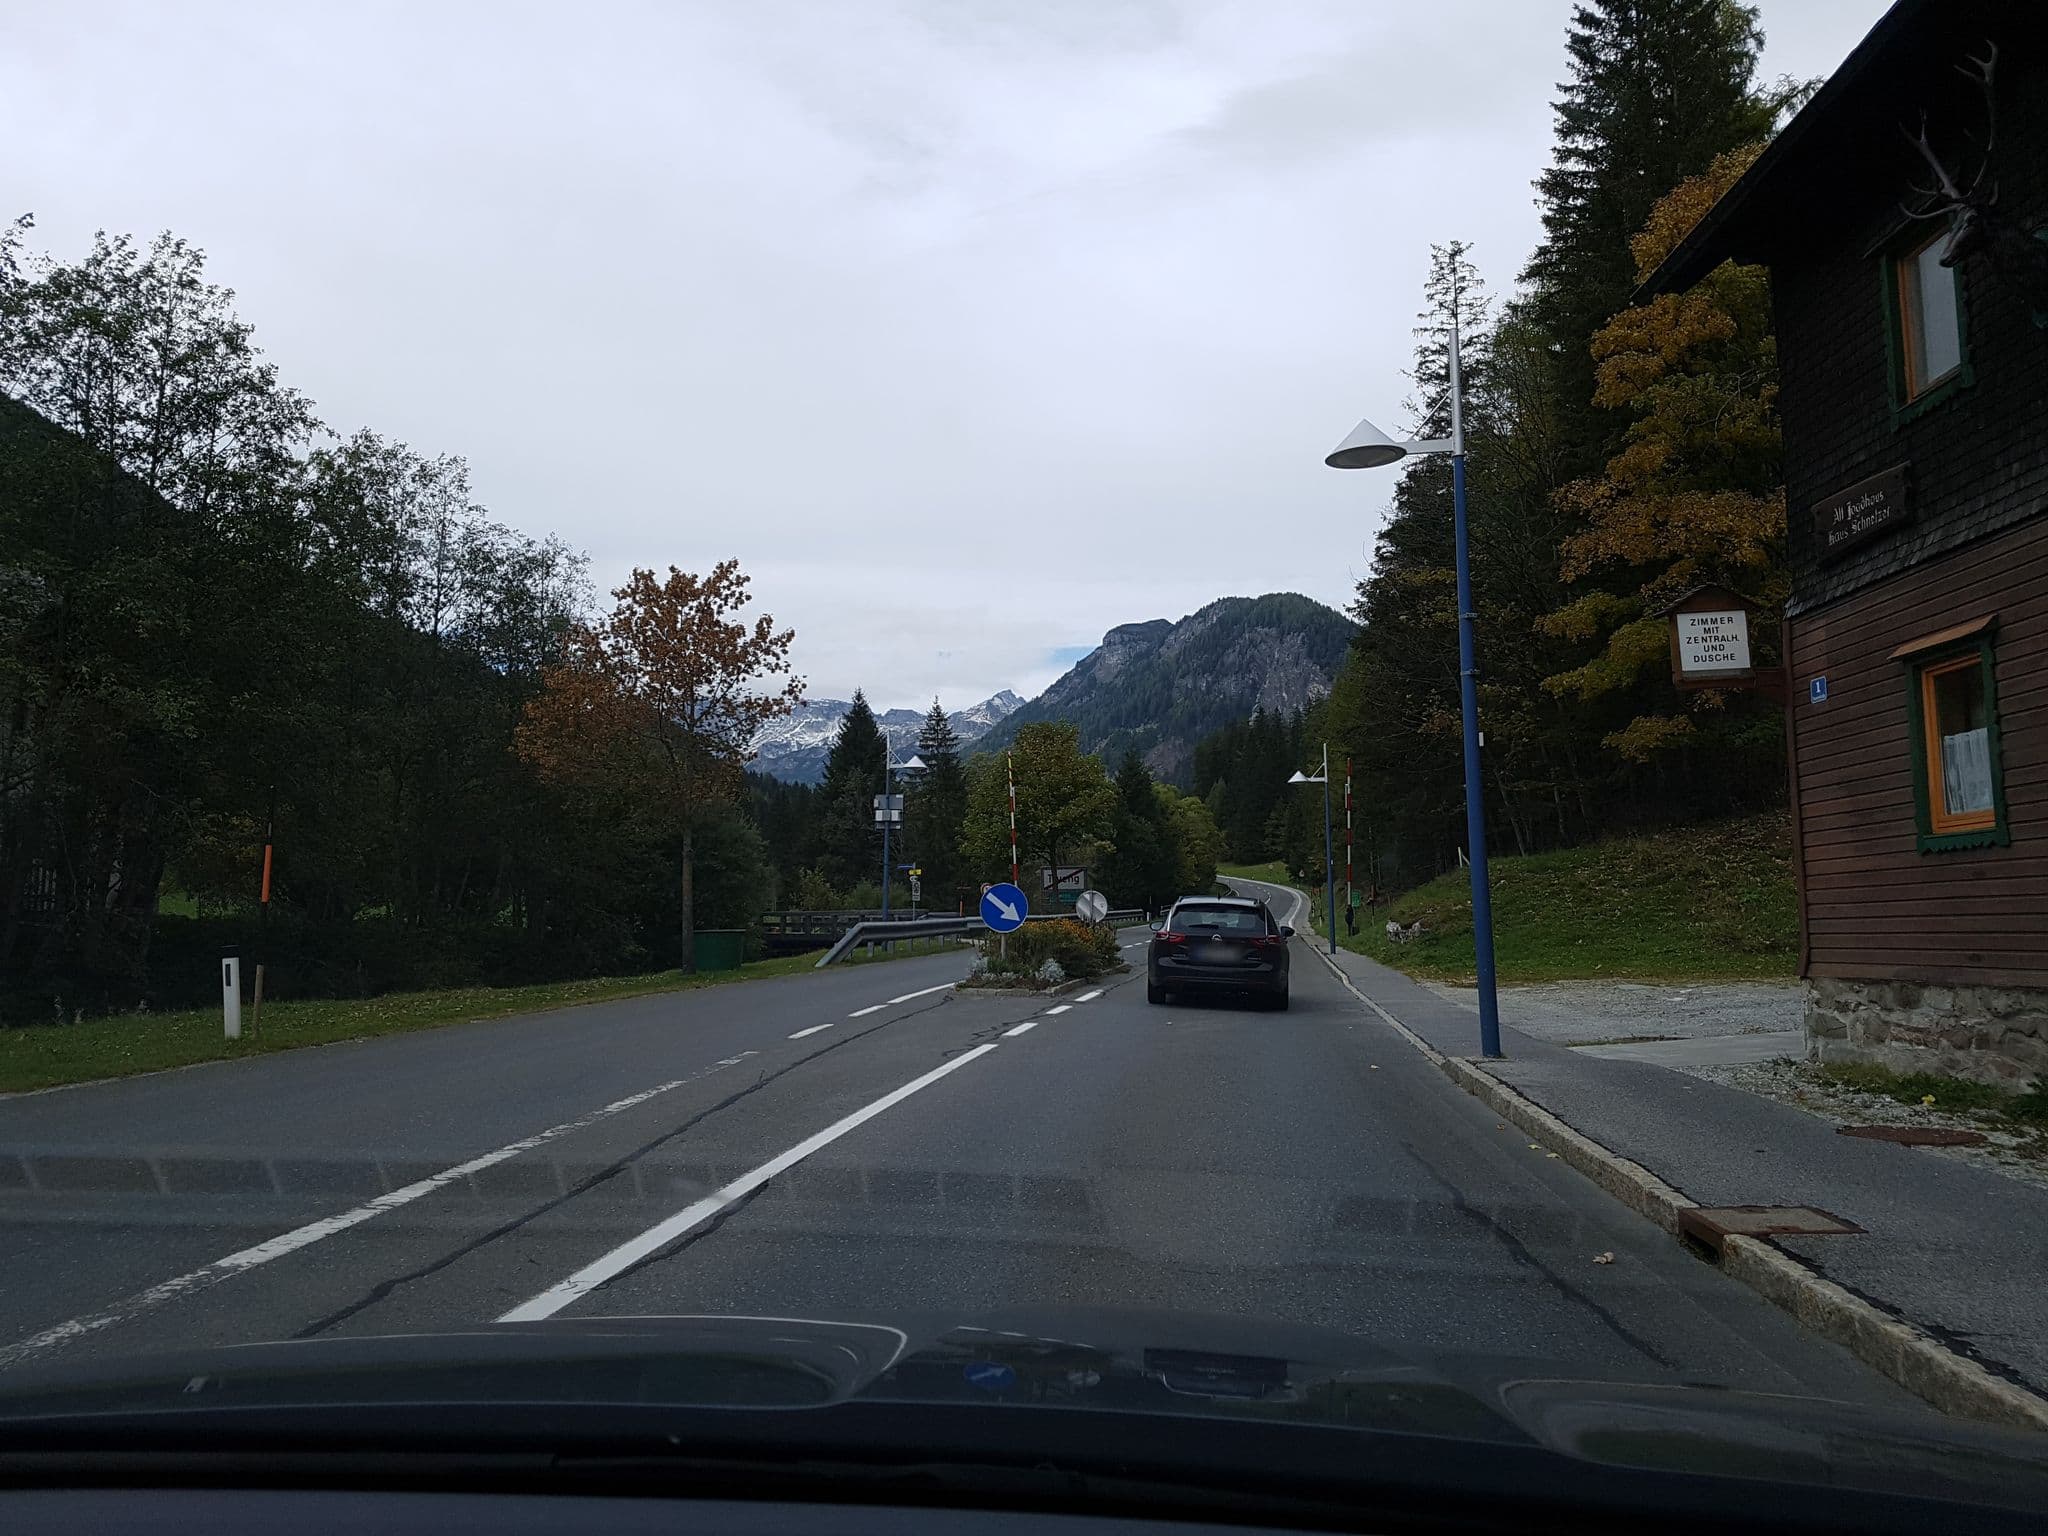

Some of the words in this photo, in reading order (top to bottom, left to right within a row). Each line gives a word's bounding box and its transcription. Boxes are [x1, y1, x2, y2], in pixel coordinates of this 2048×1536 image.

[1690, 616, 1734, 626] ZIMMER
[1703, 626, 1720, 635] MIT
[1686, 634, 1740, 644] ZENTRALH.
[1703, 644, 1725, 653] UND
[1693, 653, 1737, 663] DUSCHE
[1815, 680, 1822, 693] 1
